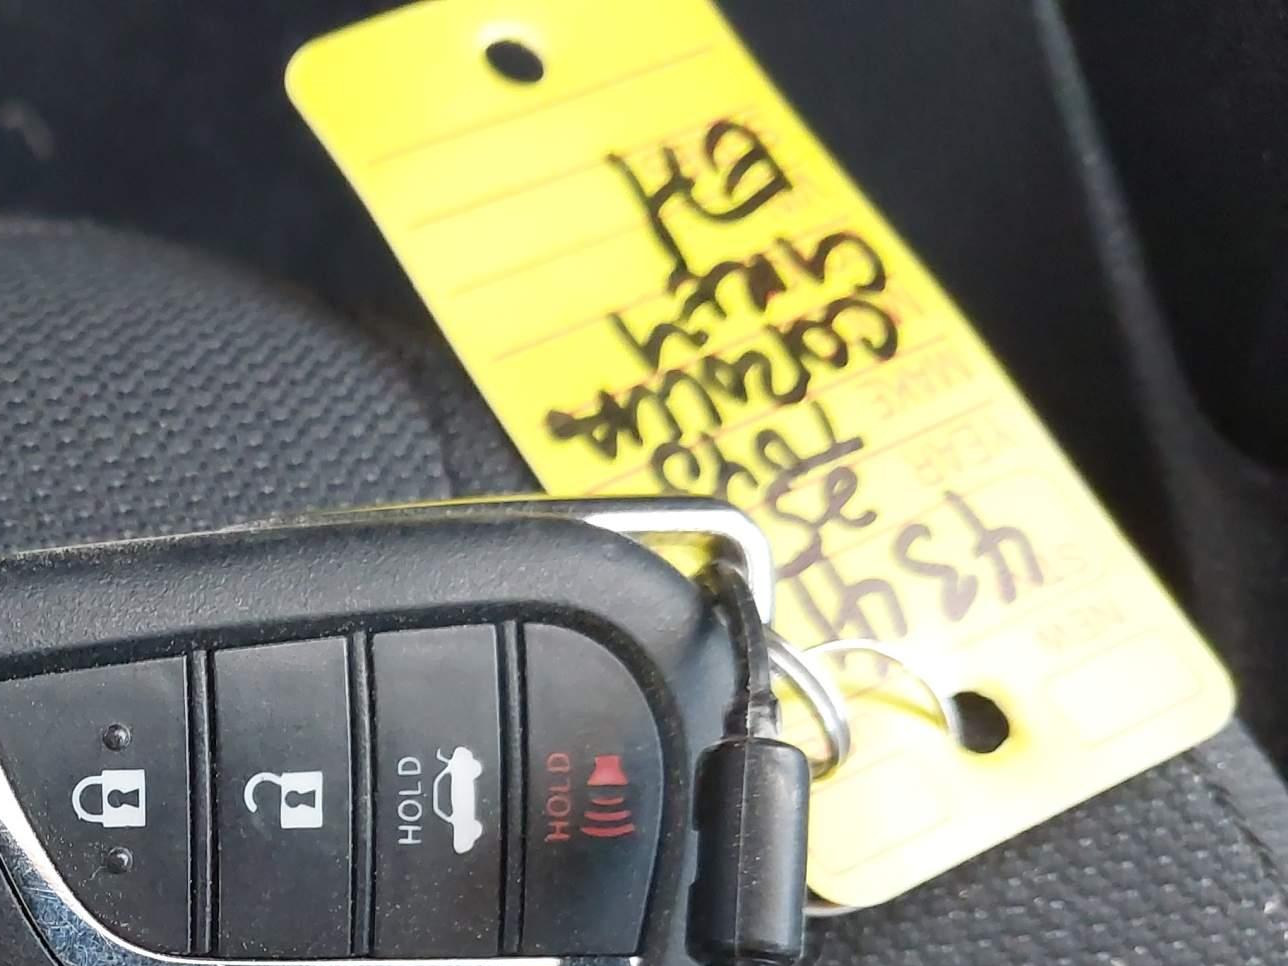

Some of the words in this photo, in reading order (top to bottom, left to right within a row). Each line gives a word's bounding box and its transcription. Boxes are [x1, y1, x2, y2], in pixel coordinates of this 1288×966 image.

[766, 466, 878, 578] 25
[397, 756, 422, 844] HOLD
[544, 753, 572, 842] HOLD
